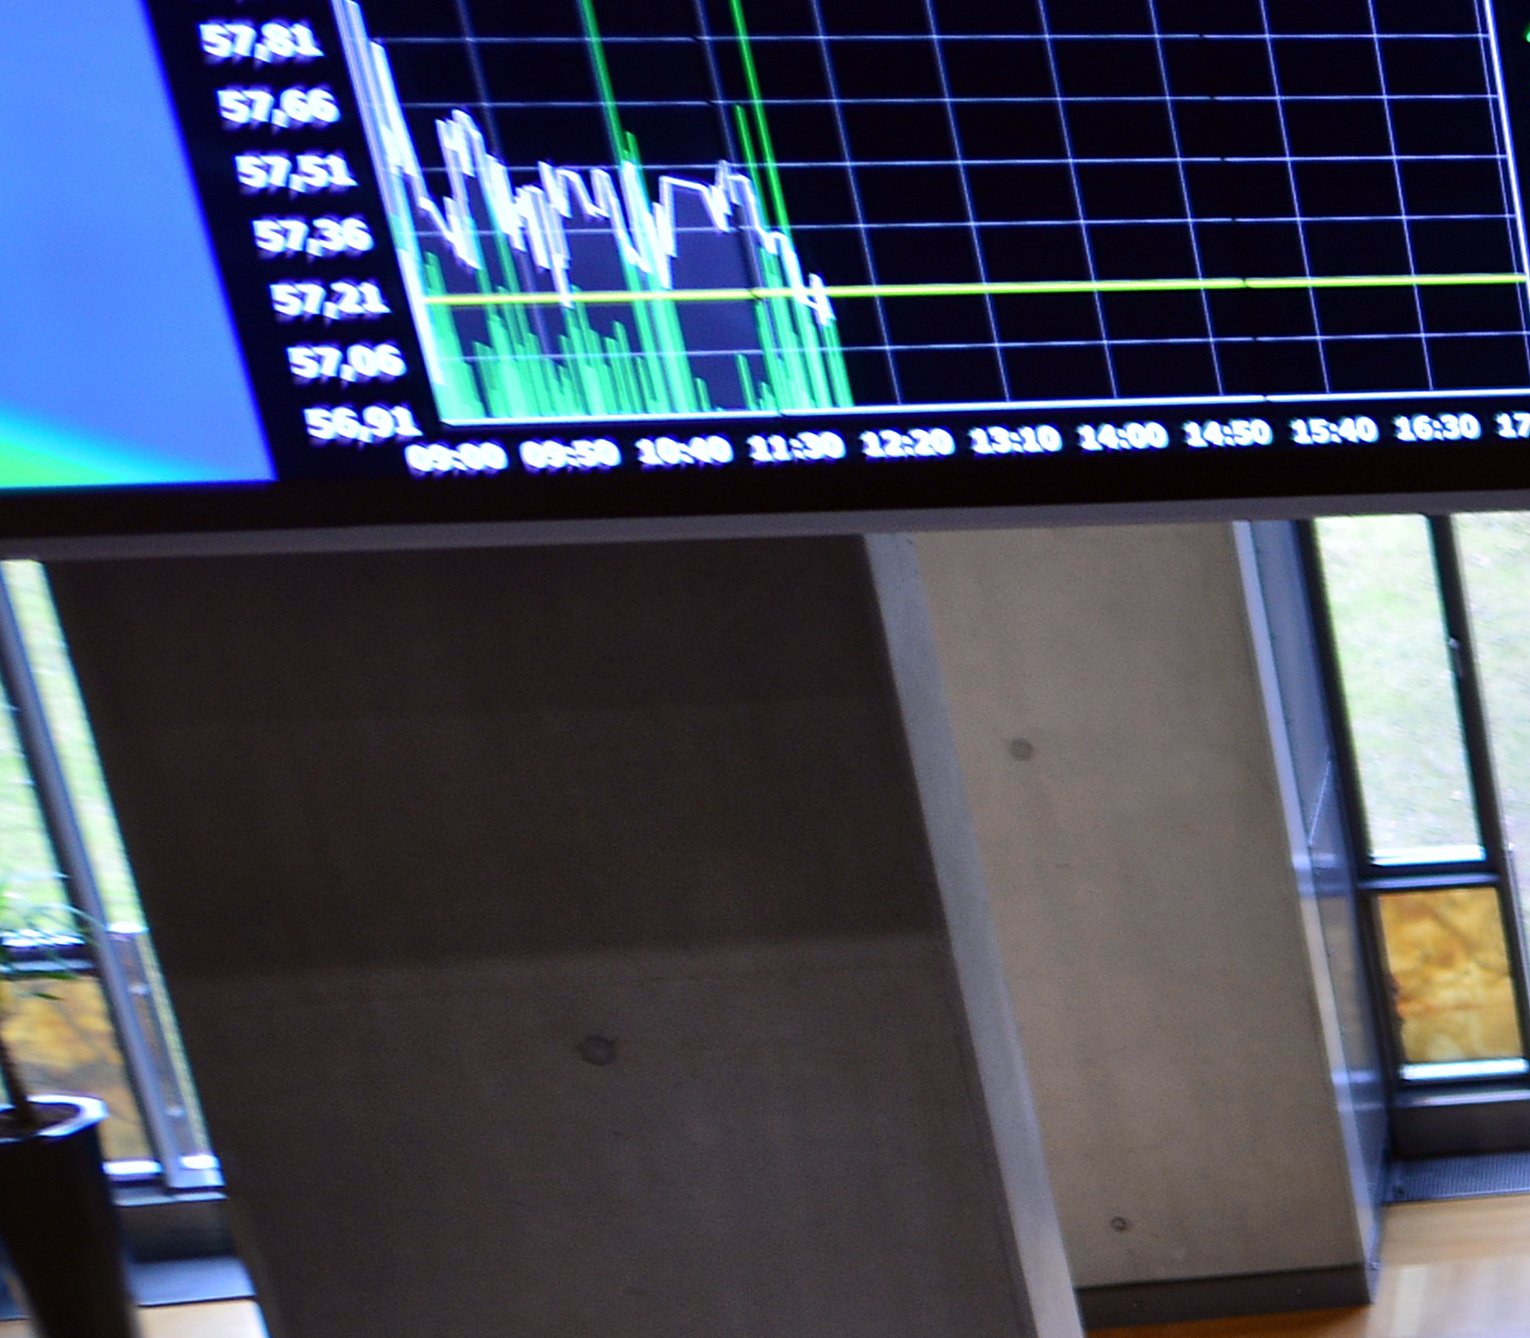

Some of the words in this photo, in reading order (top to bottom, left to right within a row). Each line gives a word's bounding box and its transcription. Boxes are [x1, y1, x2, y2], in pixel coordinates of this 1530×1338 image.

[198, 22, 325, 63] 57,81
[216, 87, 342, 128] 57,66
[235, 154, 359, 193] 57,51
[252, 217, 374, 257] 57,36
[269, 281, 392, 320] 57,21
[287, 344, 407, 382] 57,06
[304, 406, 423, 443] 56,91
[404, 442, 509, 472] 09:00
[519, 438, 621, 469] 09:50
[635, 435, 733, 465] 10:40
[747, 431, 846, 462] 11:30
[859, 428, 955, 459] 12:20
[969, 425, 1062, 454] 13:10
[1077, 421, 1168, 451] 14:00
[1184, 419, 1272, 447] 14:50
[1291, 416, 1378, 444] 15:40
[1395, 413, 1480, 441] 16:30
